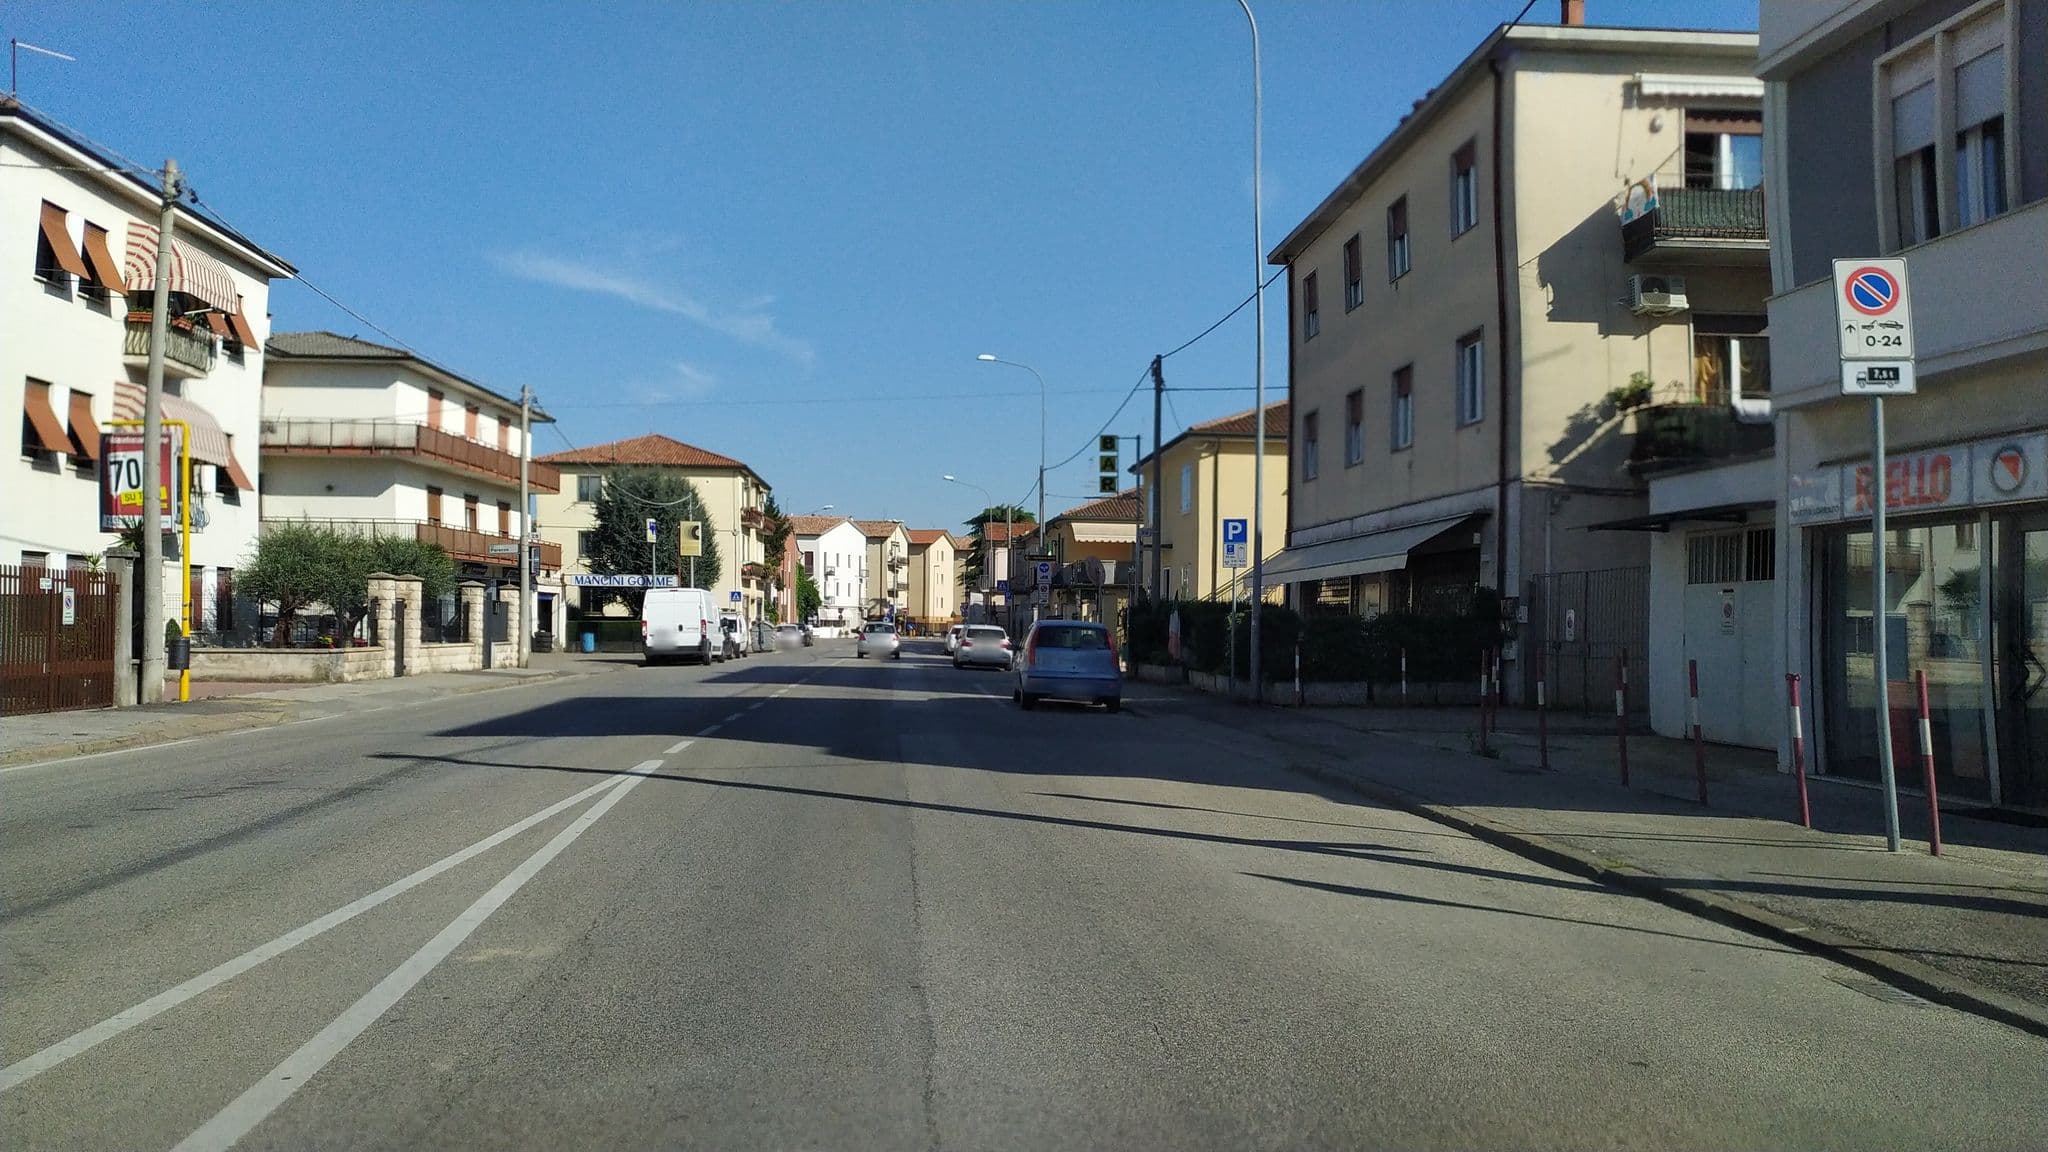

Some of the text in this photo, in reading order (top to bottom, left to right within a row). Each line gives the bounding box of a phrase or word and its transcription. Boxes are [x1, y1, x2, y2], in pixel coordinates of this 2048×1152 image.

[1865, 335, 1902, 347] 0-24
[1101, 436, 1116, 491] BAR
[1855, 453, 1953, 513] RELLO
[1228, 521, 1242, 540] P
[574, 575, 673, 587] MANCINI GOMME
